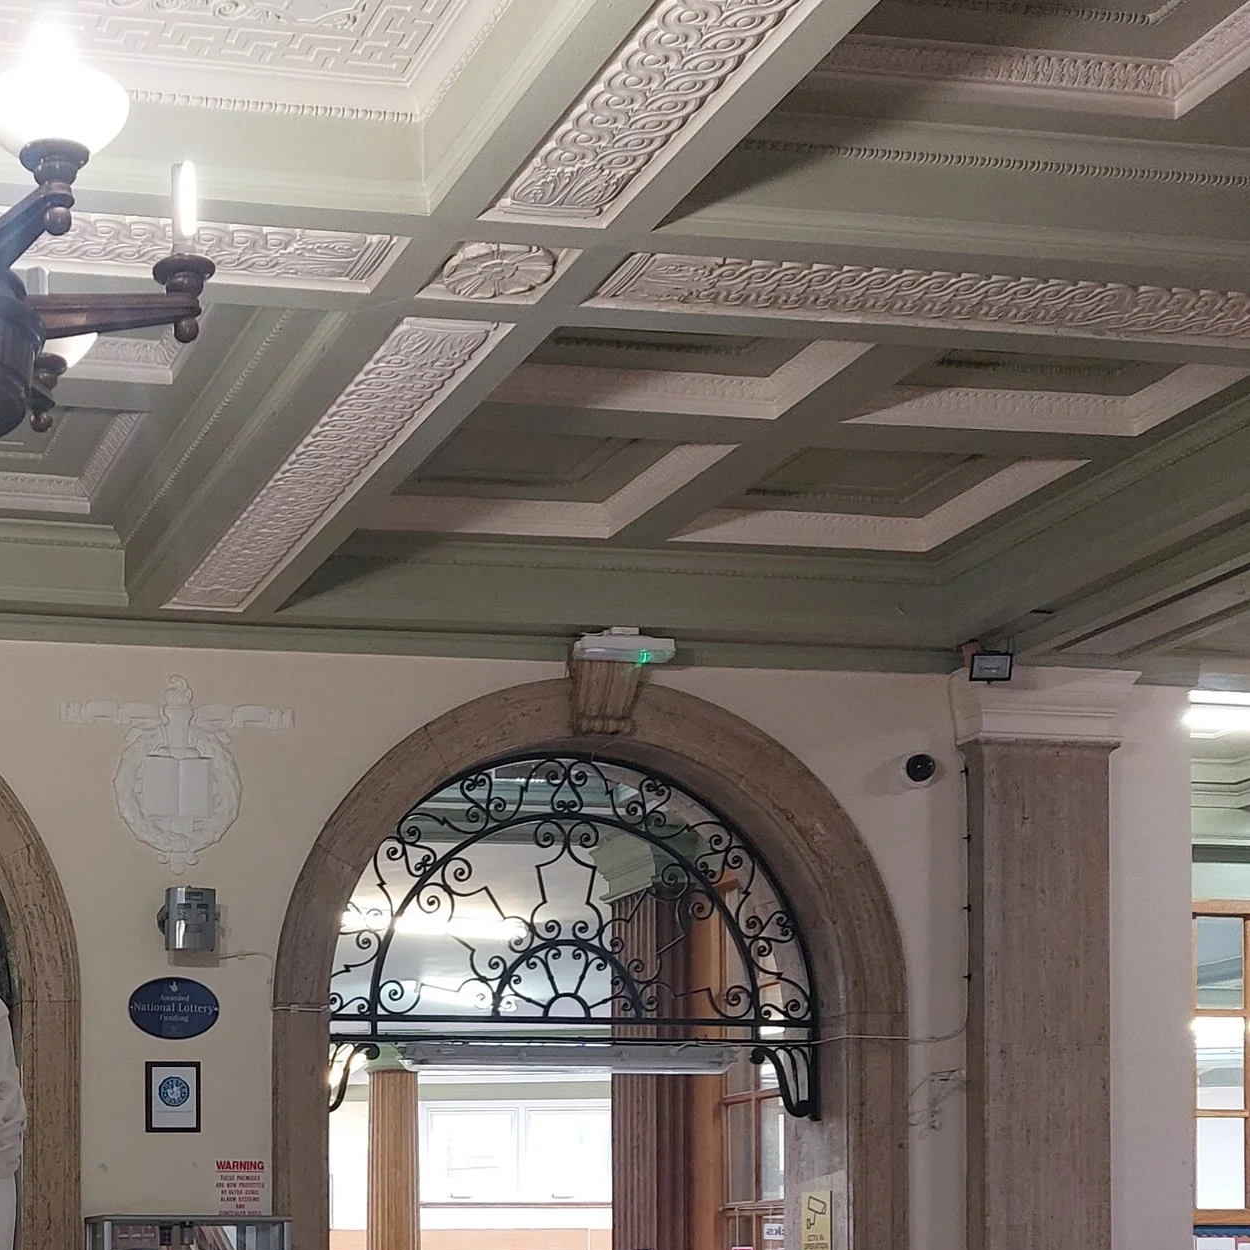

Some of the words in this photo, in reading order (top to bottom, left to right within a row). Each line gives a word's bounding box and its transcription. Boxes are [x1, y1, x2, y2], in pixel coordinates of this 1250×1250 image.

[133, 1002, 175, 1012] National
[178, 1002, 214, 1015] Lottery
[159, 1015, 189, 1023] Funding
[215, 1160, 265, 1171] WARNING
